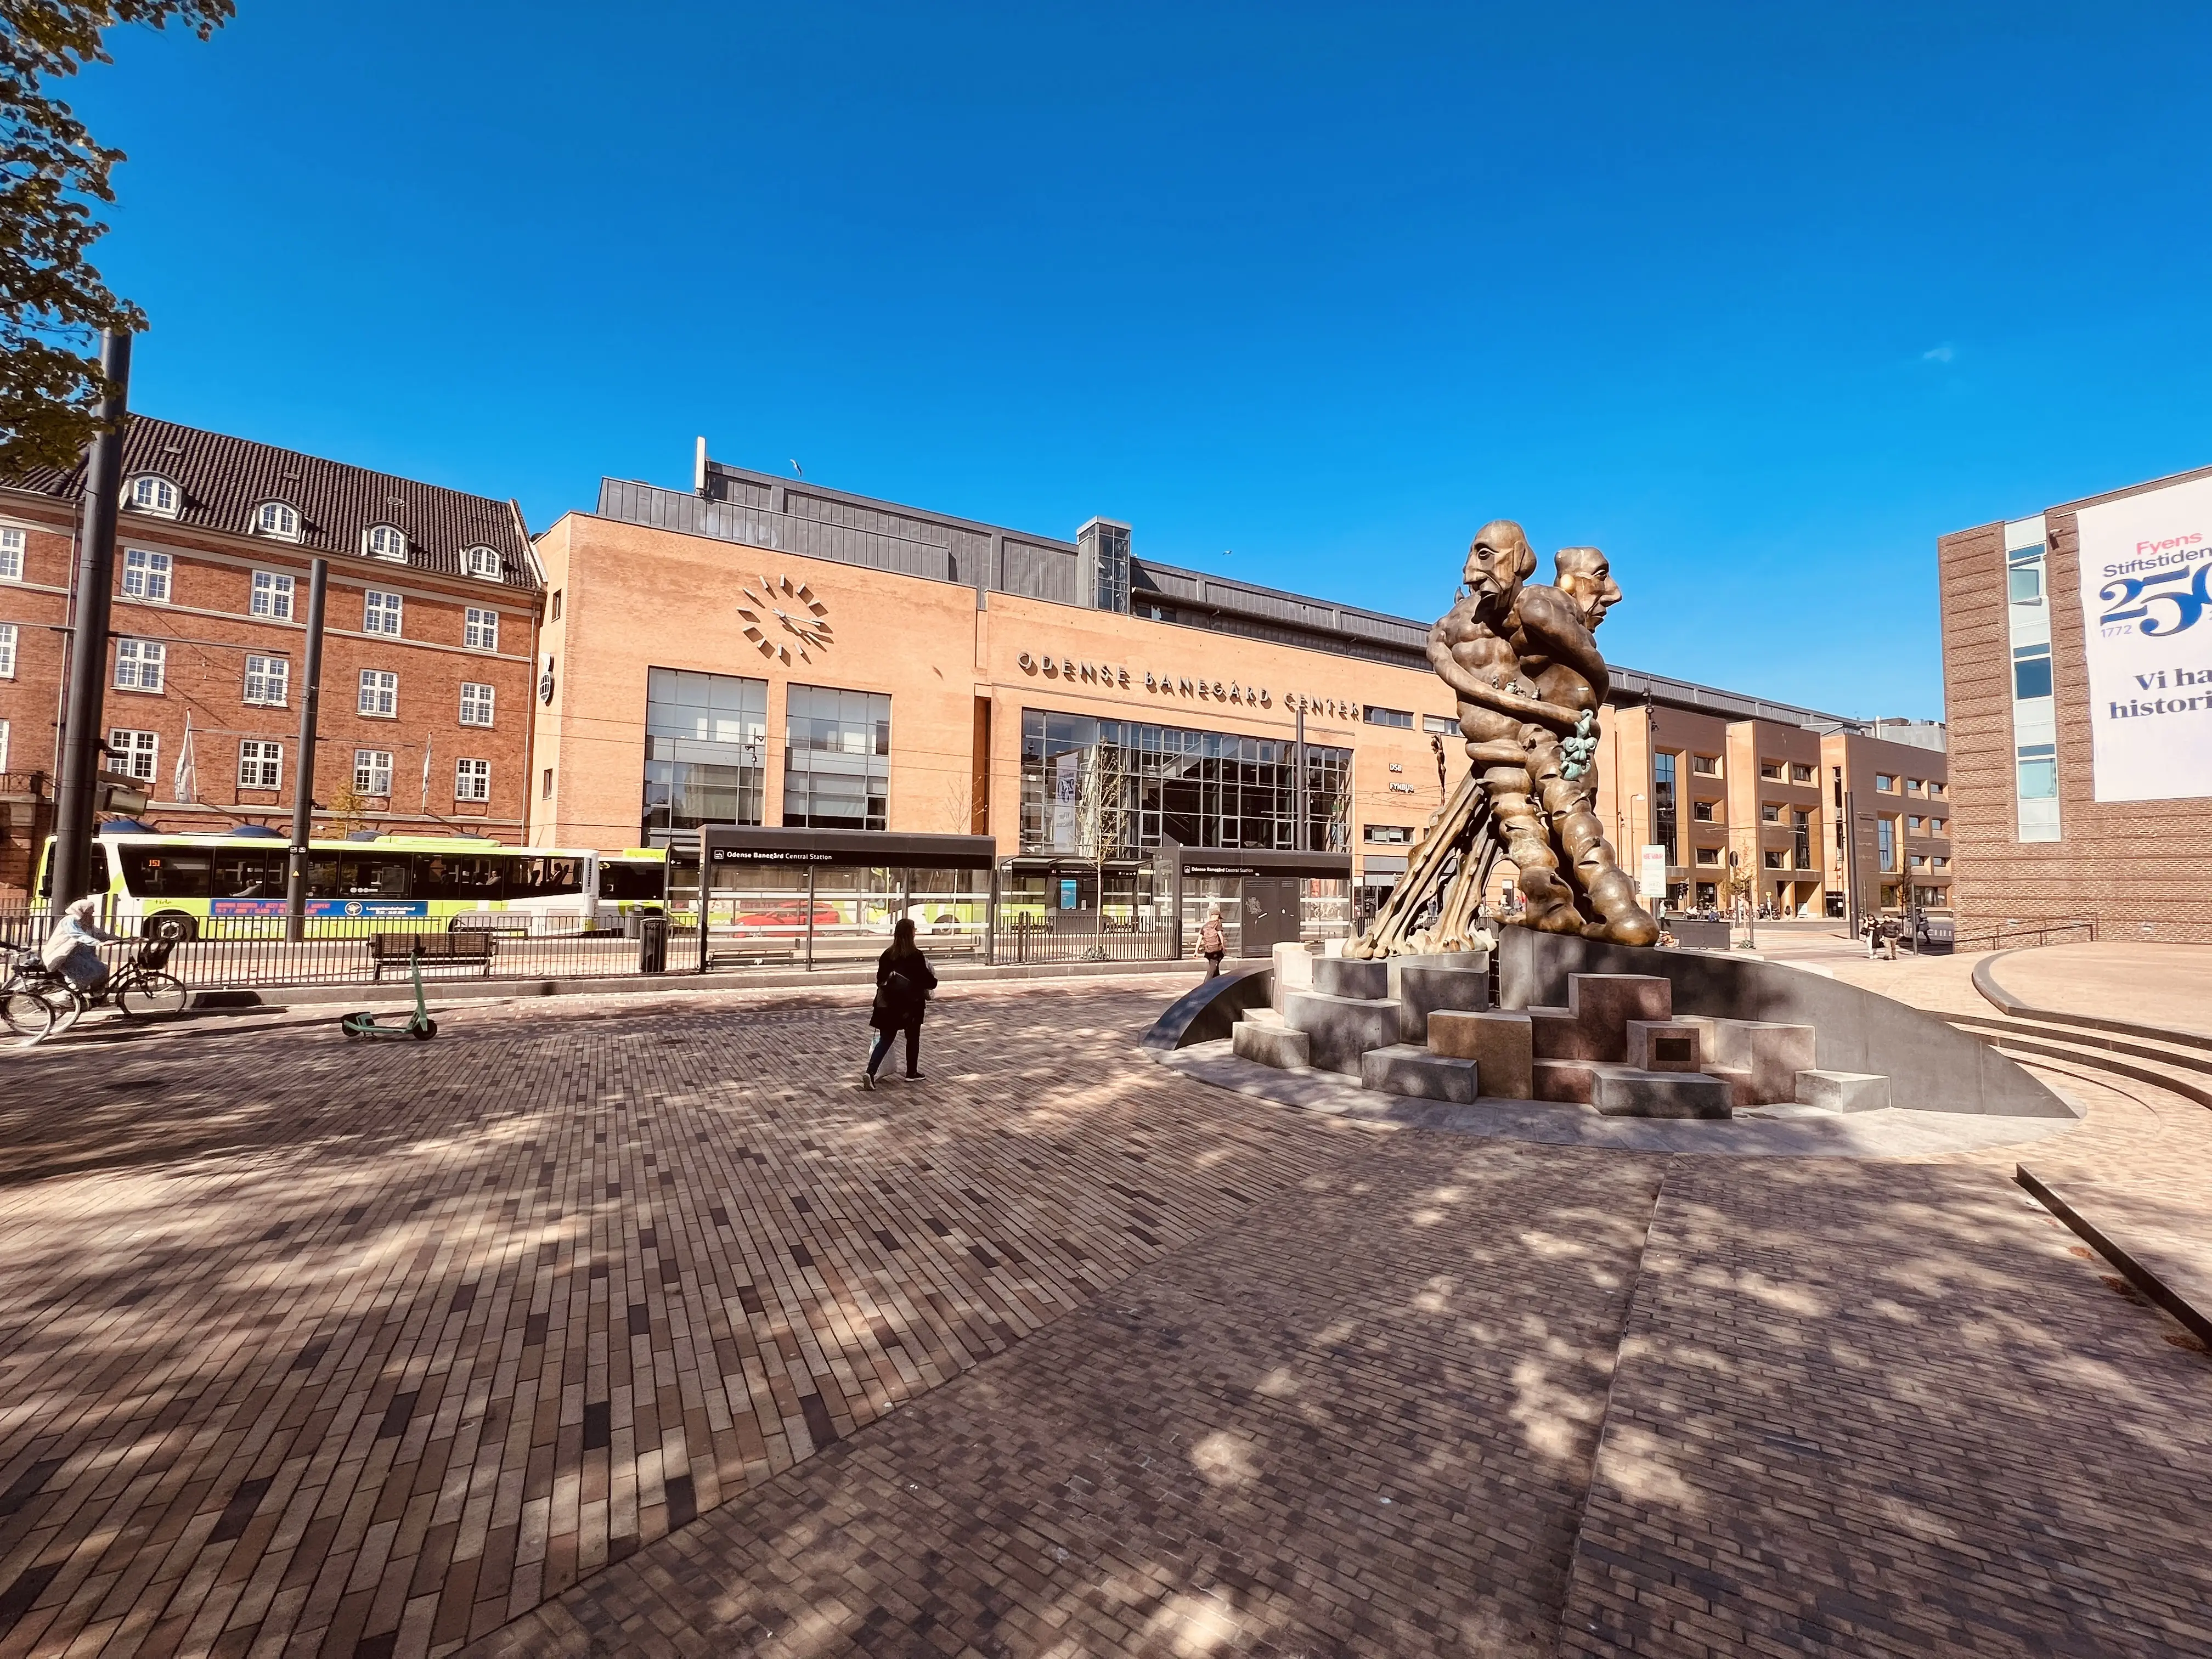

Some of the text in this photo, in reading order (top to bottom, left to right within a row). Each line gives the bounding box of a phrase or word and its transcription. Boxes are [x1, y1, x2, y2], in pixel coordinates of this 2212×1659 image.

[2136, 533, 2203, 555] Fyens
[2101, 625, 2132, 637] 1772
[1017, 650, 1358, 714] ODENSE BANEGÅRD CENTER
[2132, 670, 2168, 690] Vi
[1389, 763, 1402, 771] DSB
[1389, 782, 1414, 791] FYNBUS
[753, 851, 784, 860] Banegård
